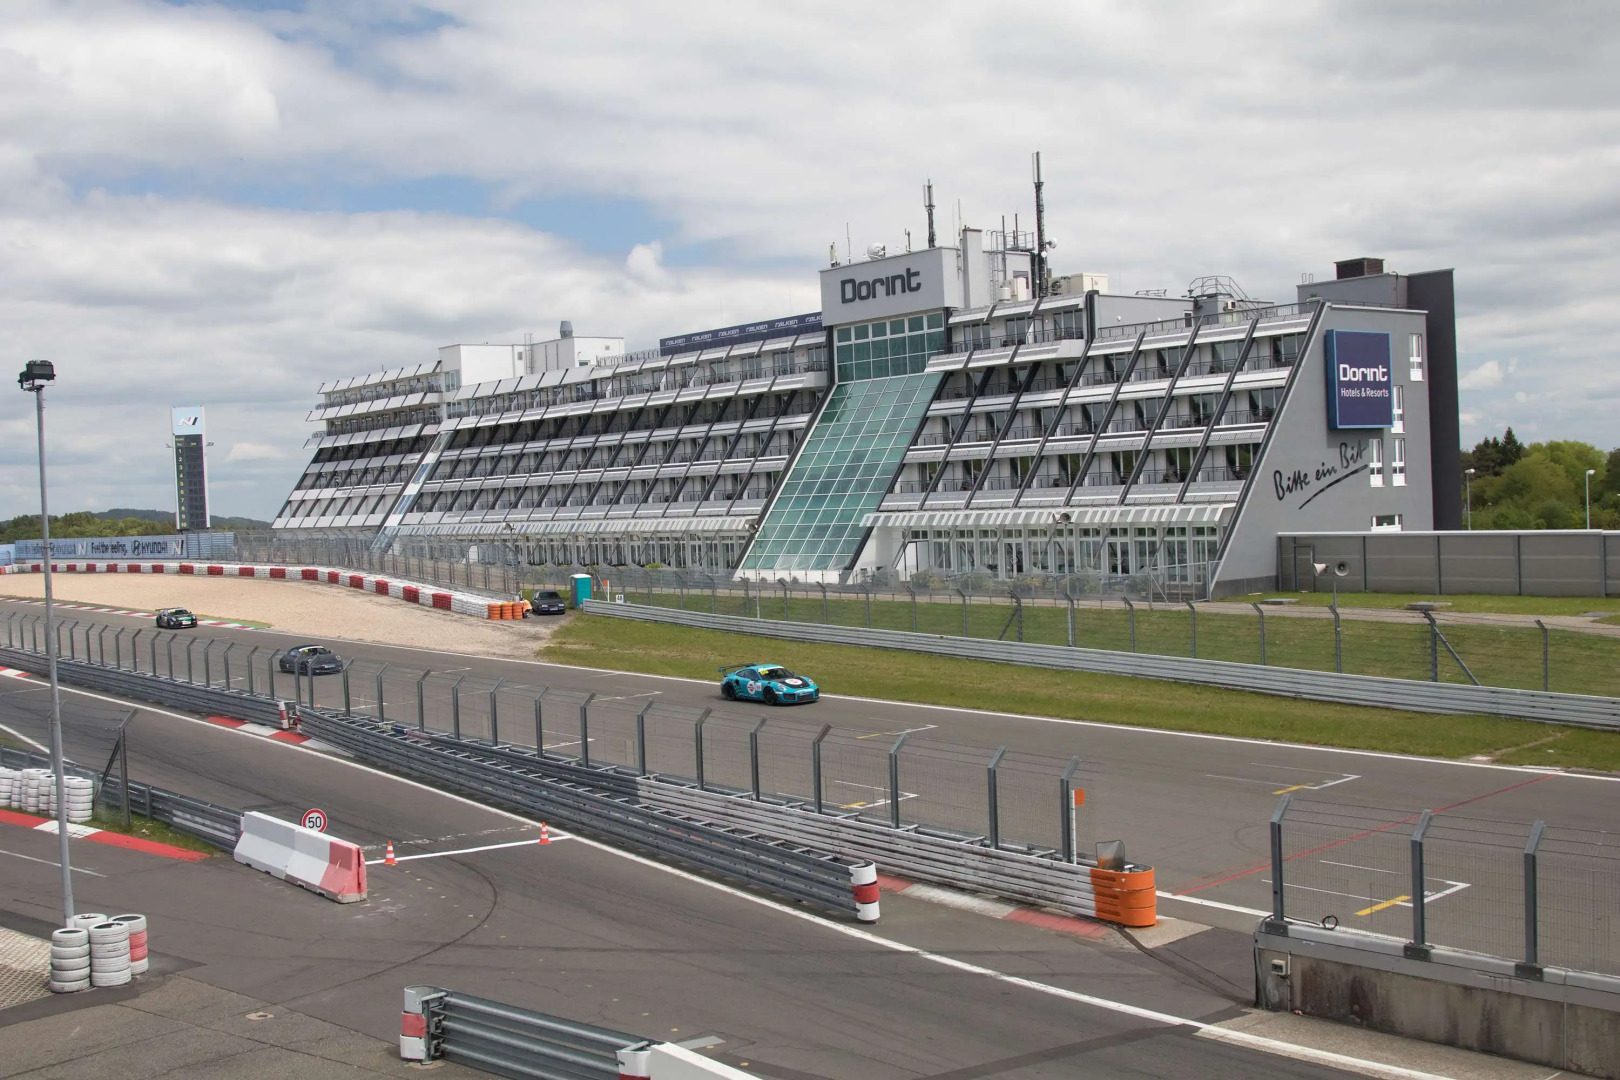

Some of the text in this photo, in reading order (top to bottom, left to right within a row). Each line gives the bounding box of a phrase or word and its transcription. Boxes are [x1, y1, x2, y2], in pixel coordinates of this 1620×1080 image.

[840, 267, 921, 304] Dorint
[691, 333, 712, 342] FALKEN
[718, 328, 740, 337] FALKEN
[745, 324, 768, 332] FALKEN
[774, 319, 798, 328] FALKEN
[1339, 363, 1388, 381] Dorint
[1340, 387, 1389, 397] Hotels & Resorts
[1273, 440, 1367, 501] Bitte ein Bit
[308, 816, 322, 829] 50
